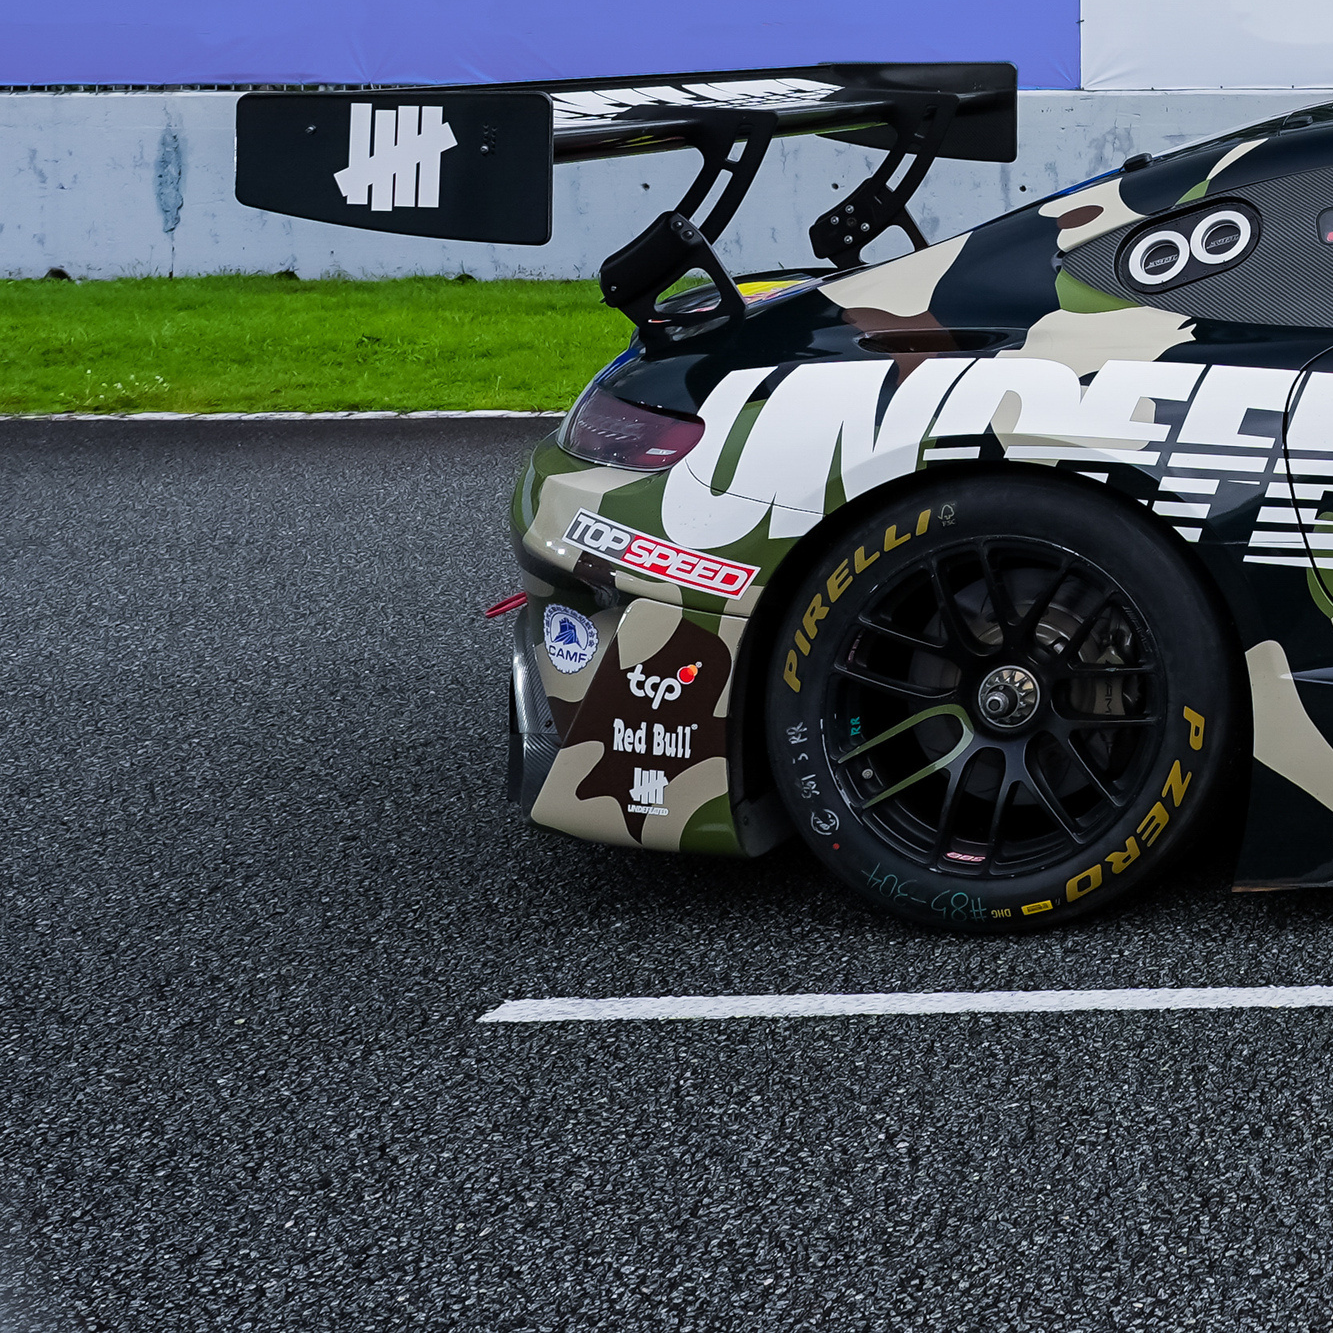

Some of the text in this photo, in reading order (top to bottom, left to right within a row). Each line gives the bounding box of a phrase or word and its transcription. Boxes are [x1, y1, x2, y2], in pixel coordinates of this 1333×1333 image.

[783, 509, 932, 693] PIRELLI
[548, 644, 588, 664] CAMF
[626, 663, 682, 710] tcp
[612, 718, 692, 759] Red Bull
[849, 716, 862, 737] RR
[1066, 705, 1206, 902] P ZERO
[991, 908, 1012, 918] DHG
